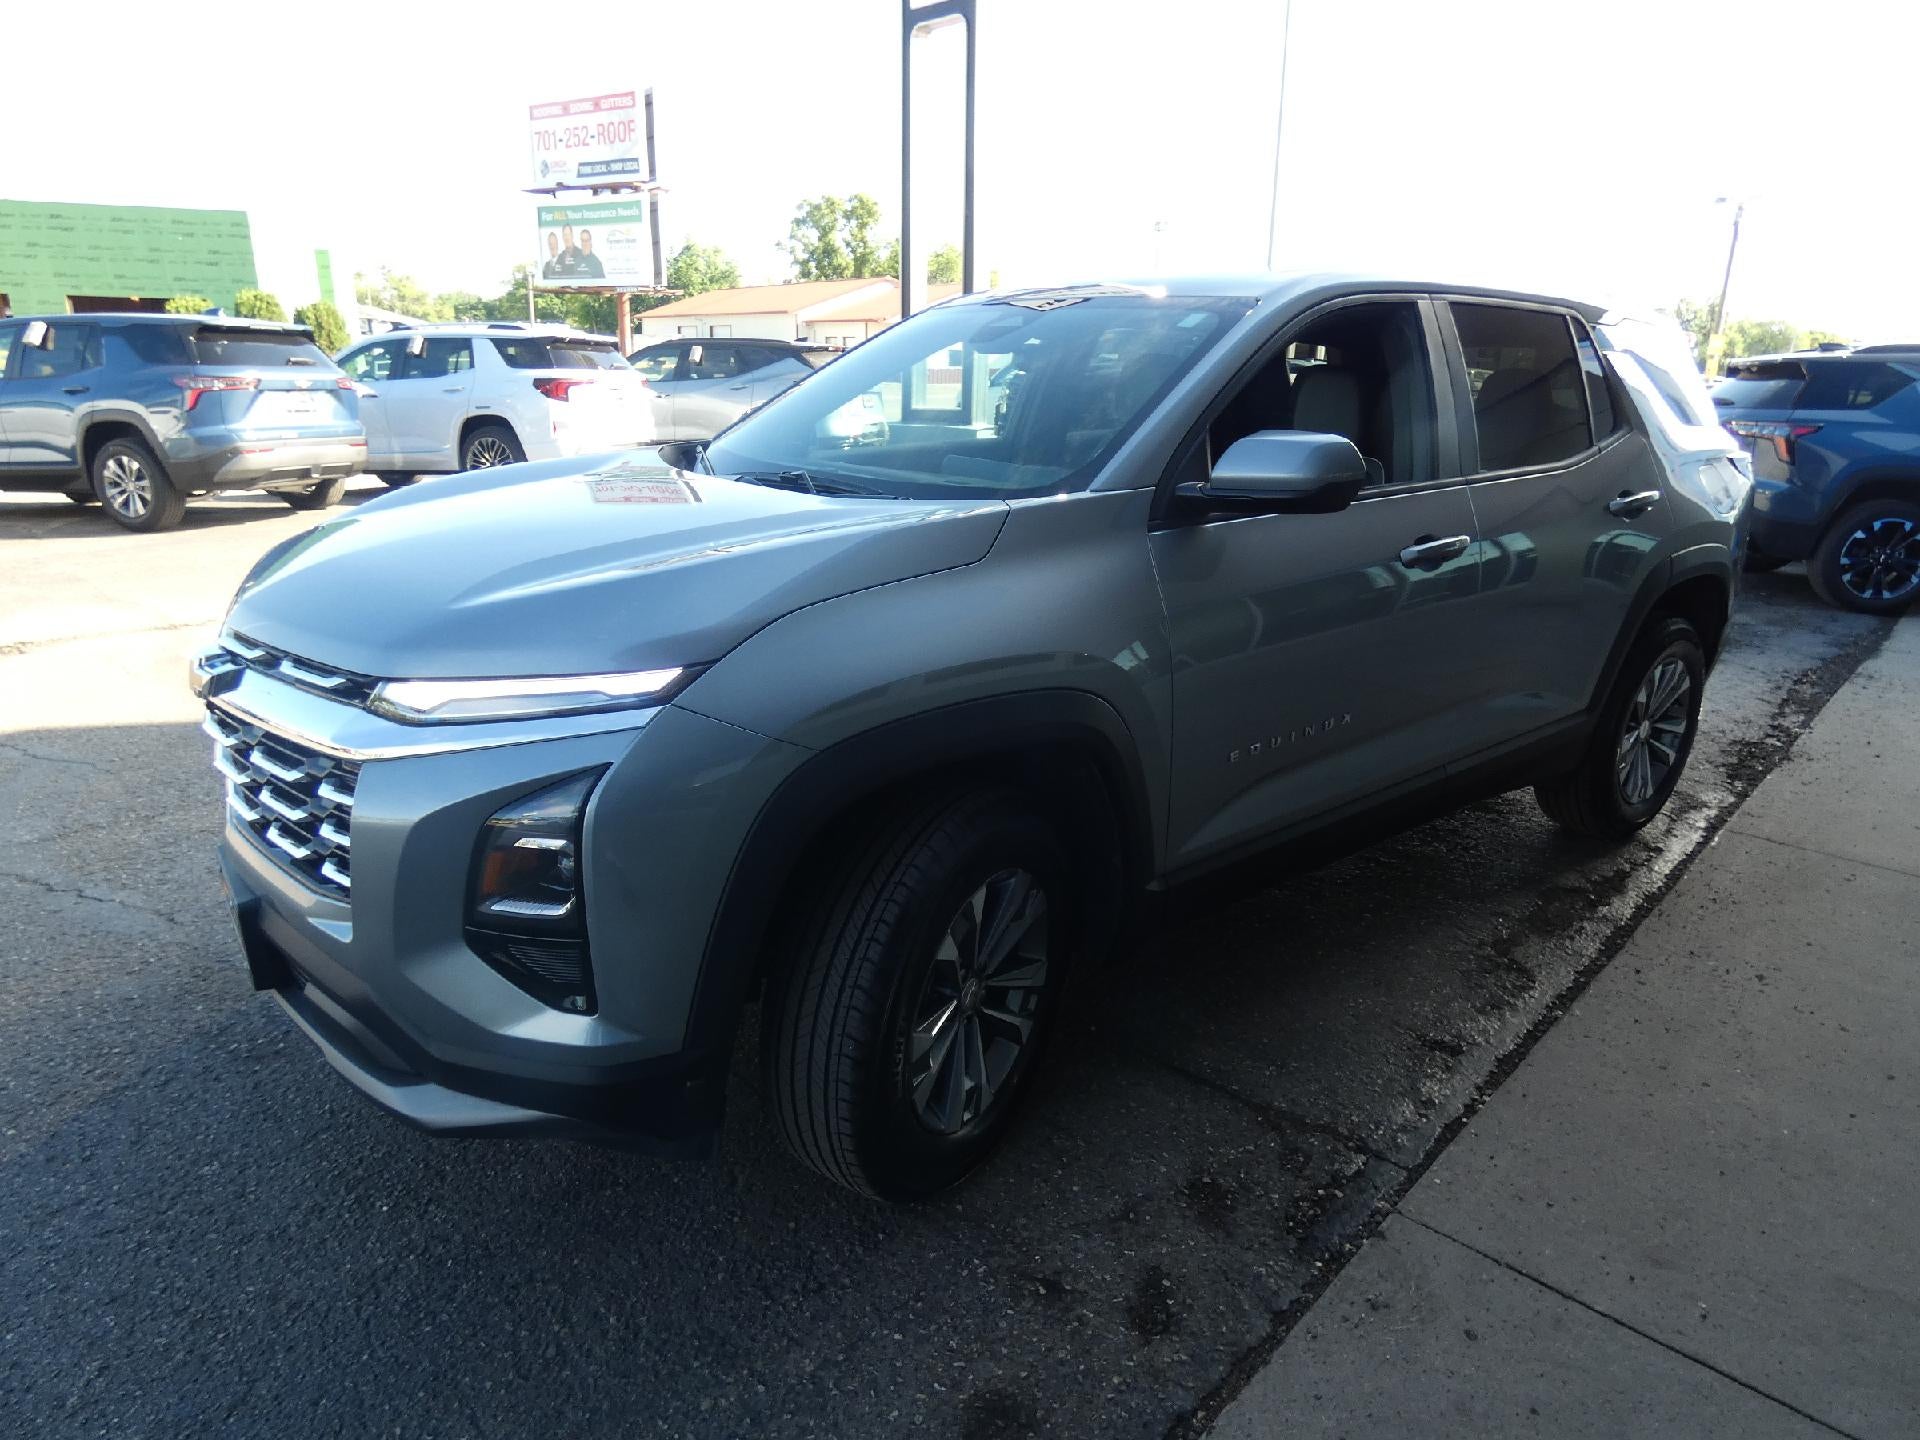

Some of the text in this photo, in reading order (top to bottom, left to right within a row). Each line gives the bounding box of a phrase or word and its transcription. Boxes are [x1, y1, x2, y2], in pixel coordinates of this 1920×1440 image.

[601, 96, 633, 109] GUTTERS
[534, 120, 635, 151] 701-252-ROOF
[624, 161, 639, 170] LOCAL
[542, 211, 553, 221] For
[567, 210, 582, 219] Your
[583, 208, 616, 219] Insurance
[618, 206, 639, 217] Needs
[1229, 712, 1352, 763] EQUINOX
